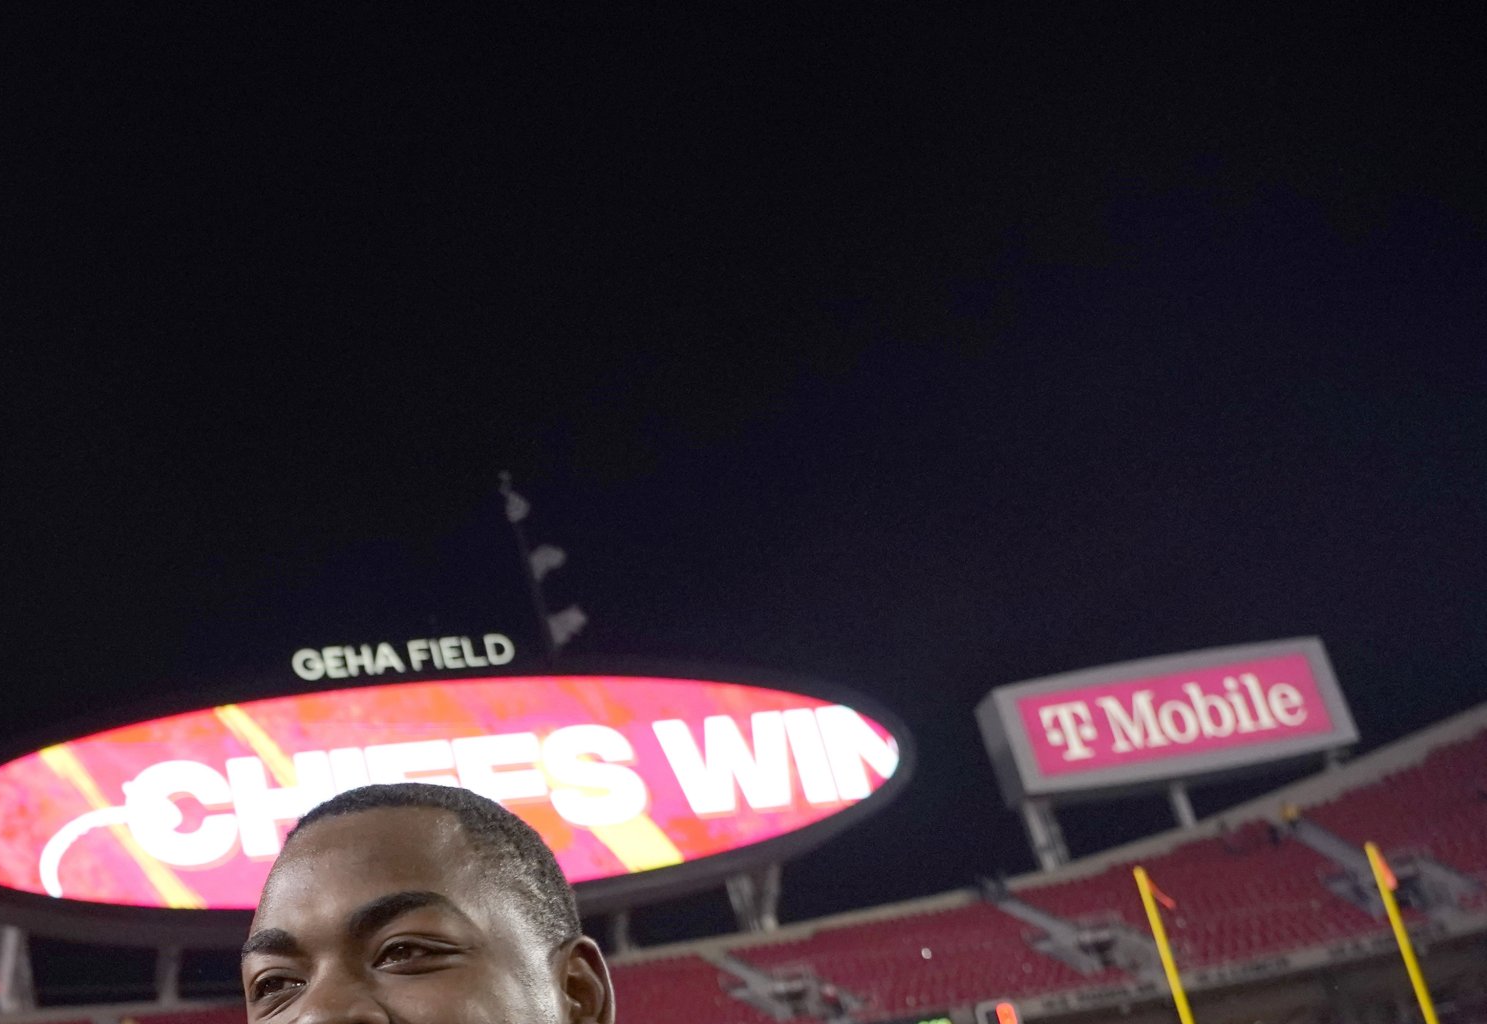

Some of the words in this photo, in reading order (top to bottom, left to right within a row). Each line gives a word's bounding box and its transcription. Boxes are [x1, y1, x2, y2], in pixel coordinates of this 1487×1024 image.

[292, 642, 406, 681] GEHA
[407, 633, 515, 672] FIELD
[652, 704, 900, 815] WIN
[1038, 702, 1098, 762] T
[1097, 673, 1308, 754] Mobile
